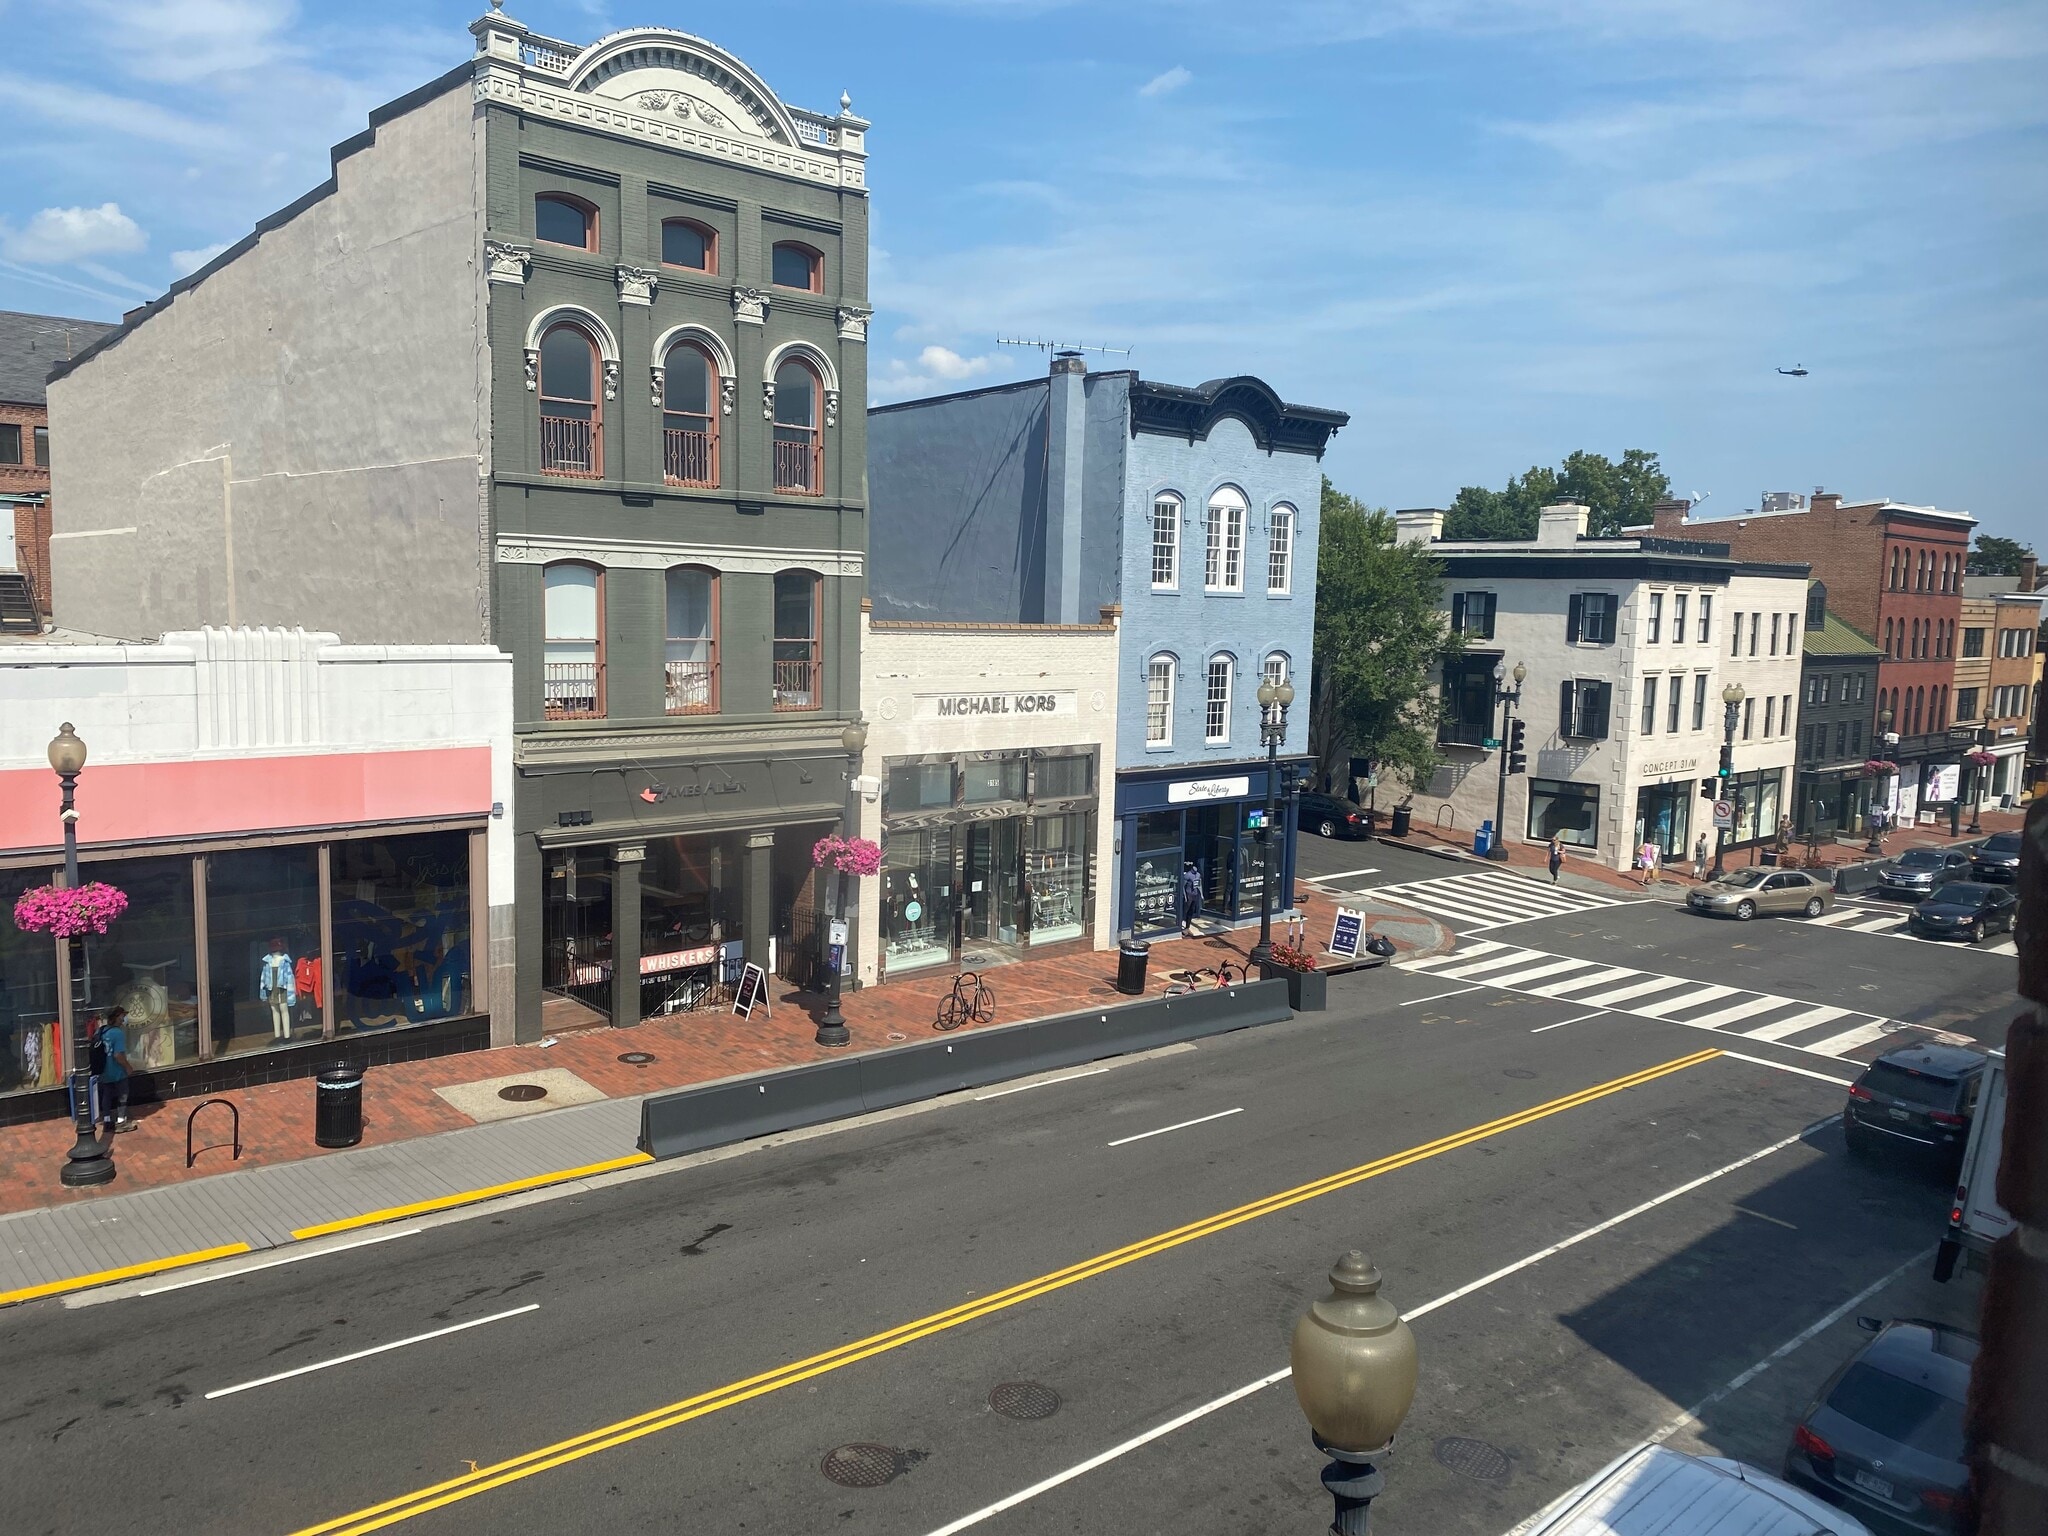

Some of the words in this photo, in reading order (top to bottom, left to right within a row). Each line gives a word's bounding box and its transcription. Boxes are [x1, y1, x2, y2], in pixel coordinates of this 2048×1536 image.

[937, 697, 1010, 716] MICHAEL
[1014, 695, 1056, 713] KORS
[1643, 761, 1678, 774] CONCEPT
[1189, 783, 1207, 796] State
[646, 950, 713, 971] WHISKERS
